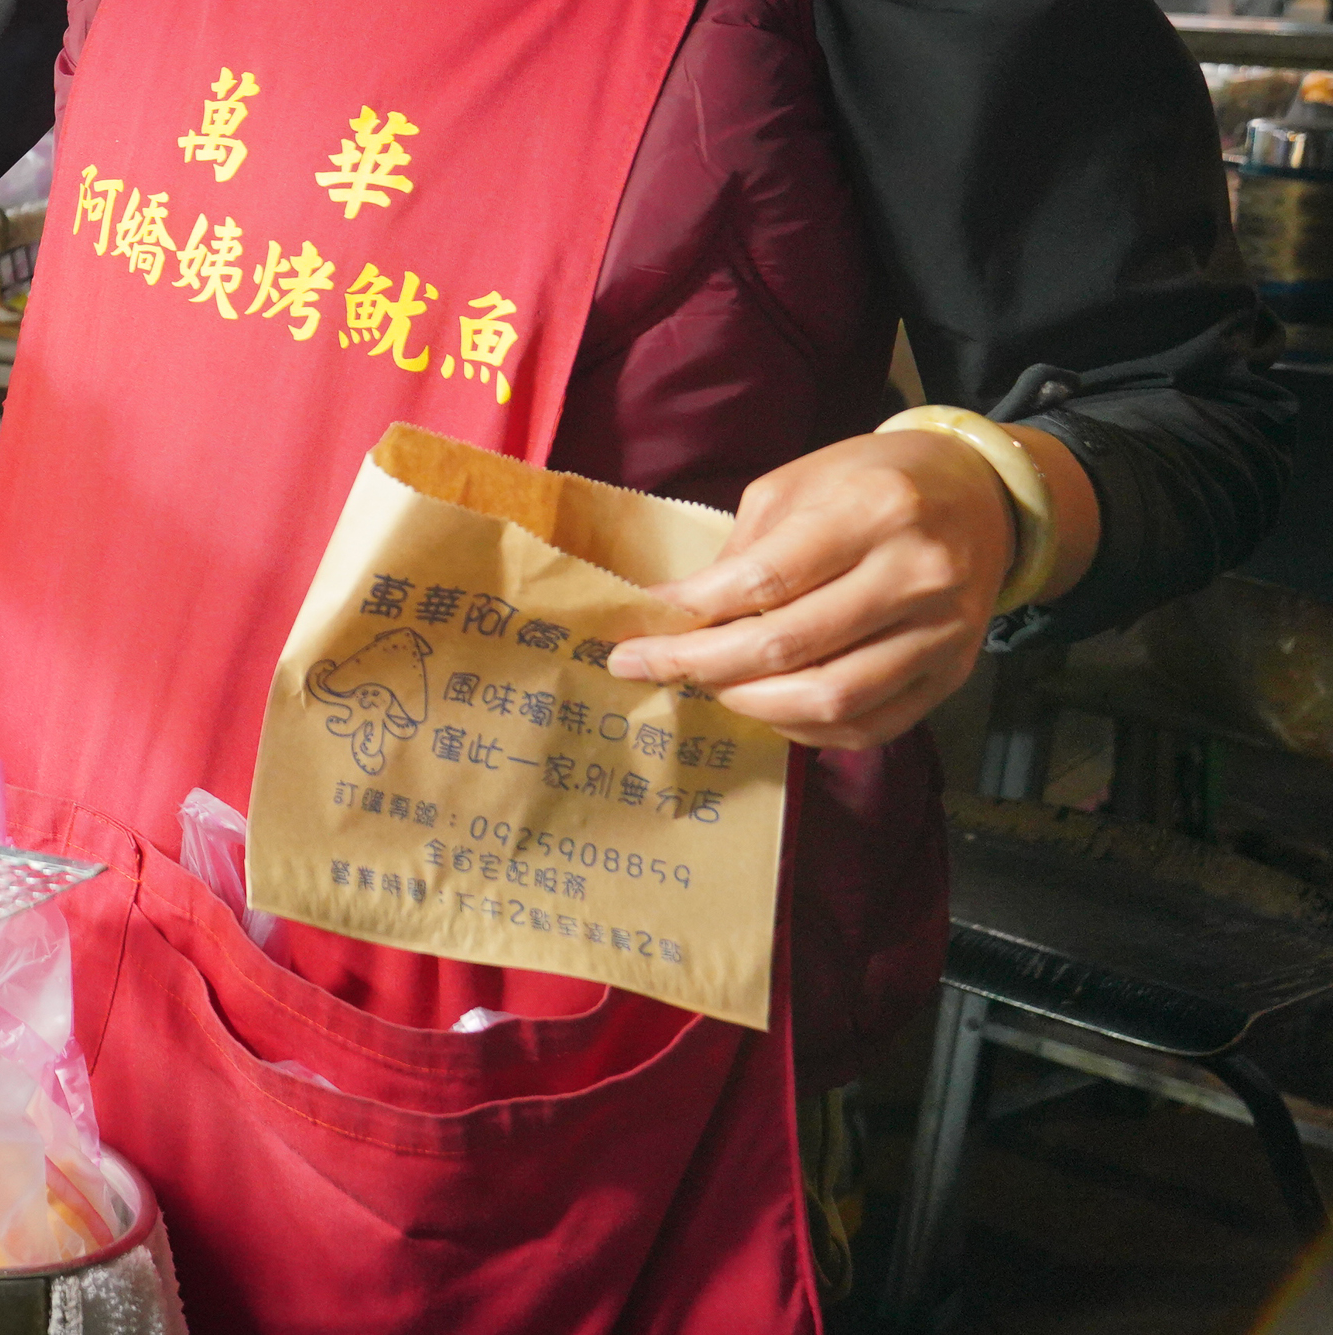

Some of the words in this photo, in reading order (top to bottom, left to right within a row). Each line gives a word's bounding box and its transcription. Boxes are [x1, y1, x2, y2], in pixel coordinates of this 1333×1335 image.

[177, 66, 420, 220] 萬華
[72, 164, 519, 406] 阿嬌姨烤魷魚
